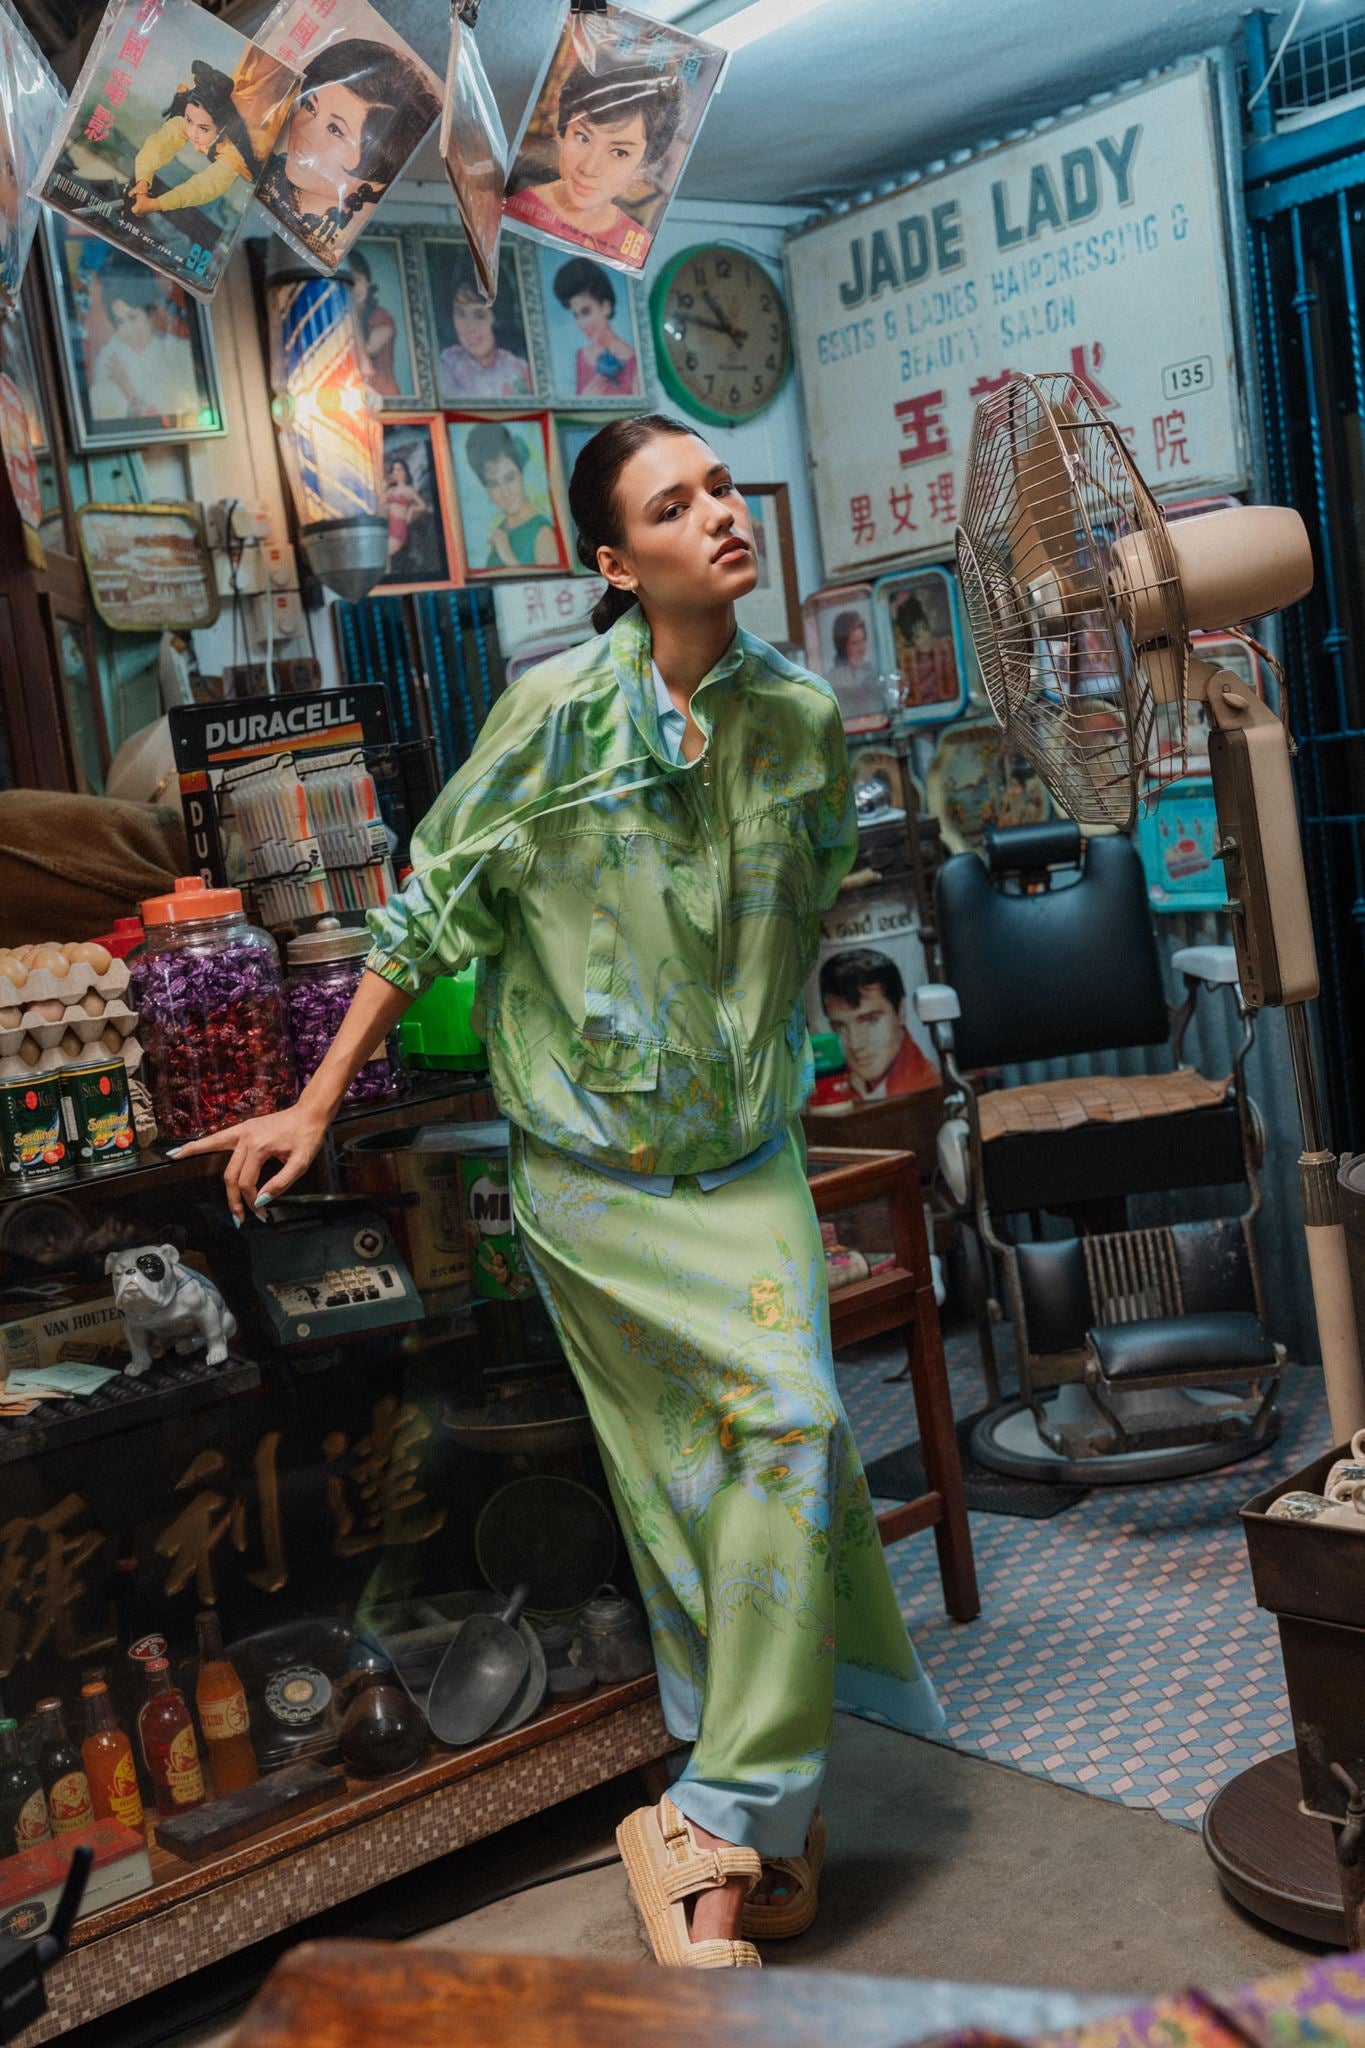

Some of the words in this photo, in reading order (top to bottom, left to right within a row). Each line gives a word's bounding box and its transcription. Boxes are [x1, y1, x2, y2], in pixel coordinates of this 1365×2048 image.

[838, 199, 967, 309] JADE
[991, 123, 1144, 252] LADY
[884, 314, 899, 342] &
[906, 280, 980, 336] LADIES
[900, 323, 981, 383] BEAUTY
[1000, 295, 1078, 350] SALON
[704, 375, 715, 395] 7
[729, 385, 740, 404] 6
[1171, 364, 1205, 392] 135
[206, 698, 355, 750] DURACELL
[43, 1320, 70, 1337] VAN
[73, 1306, 126, 1331] HOUTEN
